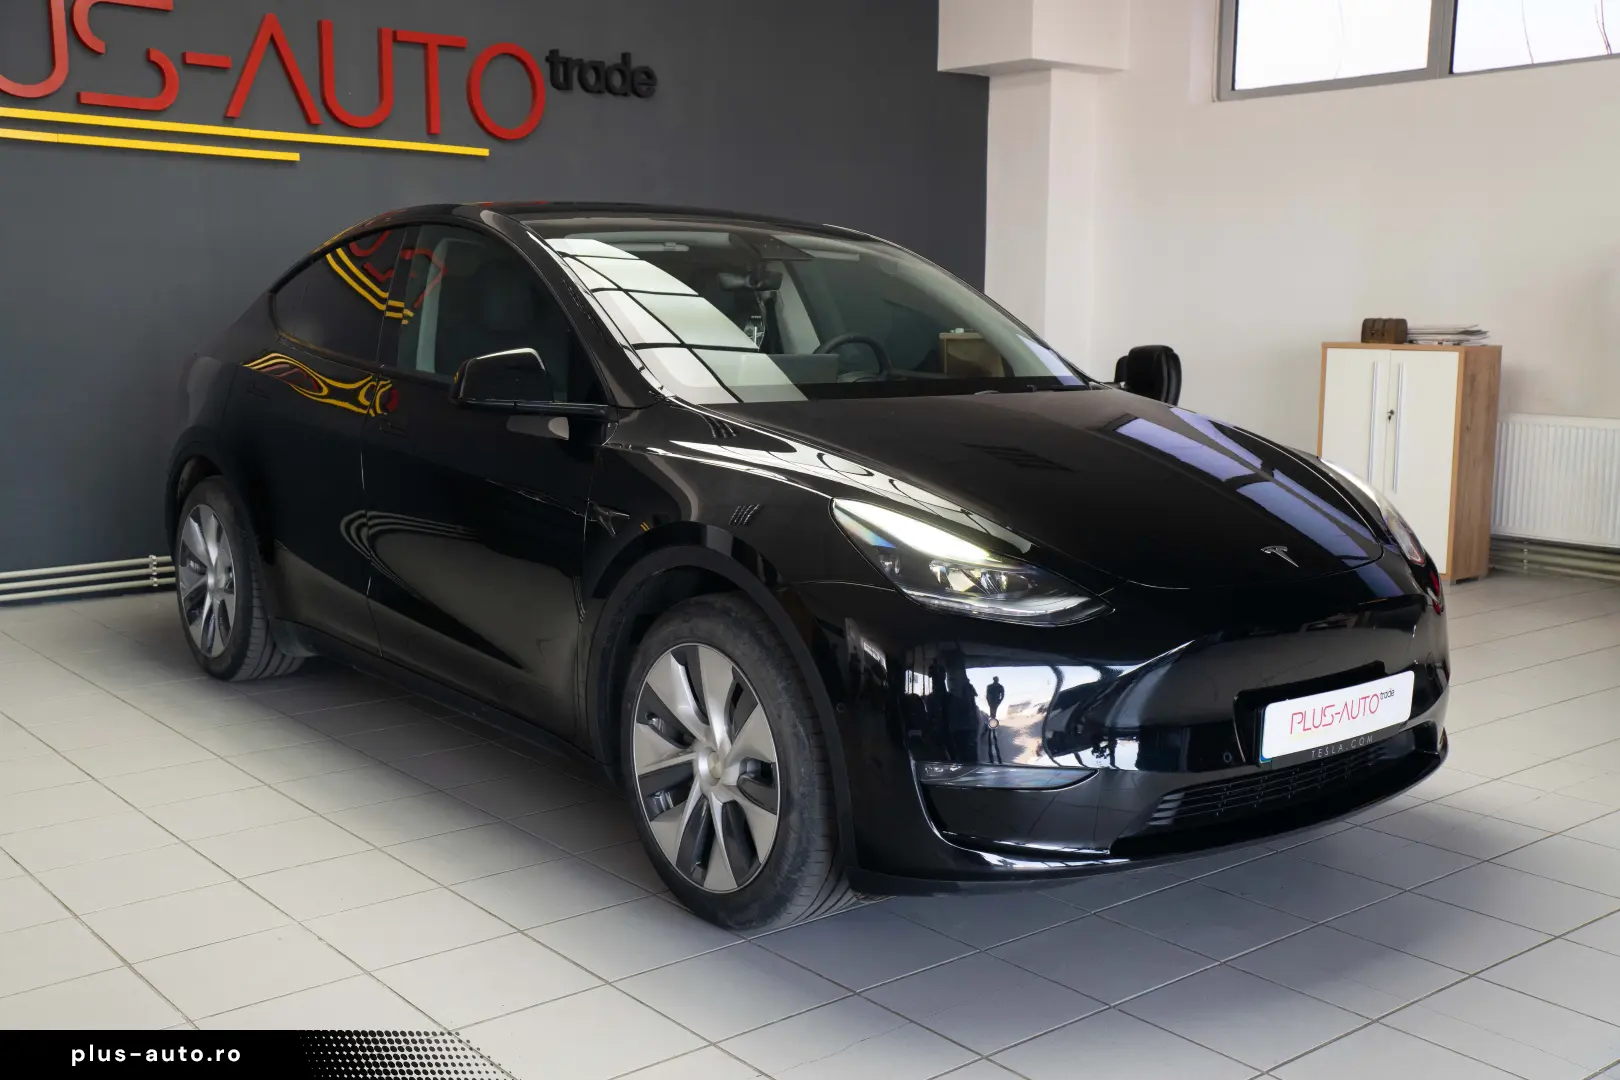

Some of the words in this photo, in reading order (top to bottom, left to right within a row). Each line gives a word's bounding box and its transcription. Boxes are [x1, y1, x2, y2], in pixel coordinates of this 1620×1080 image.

[546, 48, 656, 98] trade
[1290, 693, 1380, 734] PLUS-AUTO
[1379, 688, 1395, 700] trade
[1311, 735, 1374, 758] TESLA.COM
